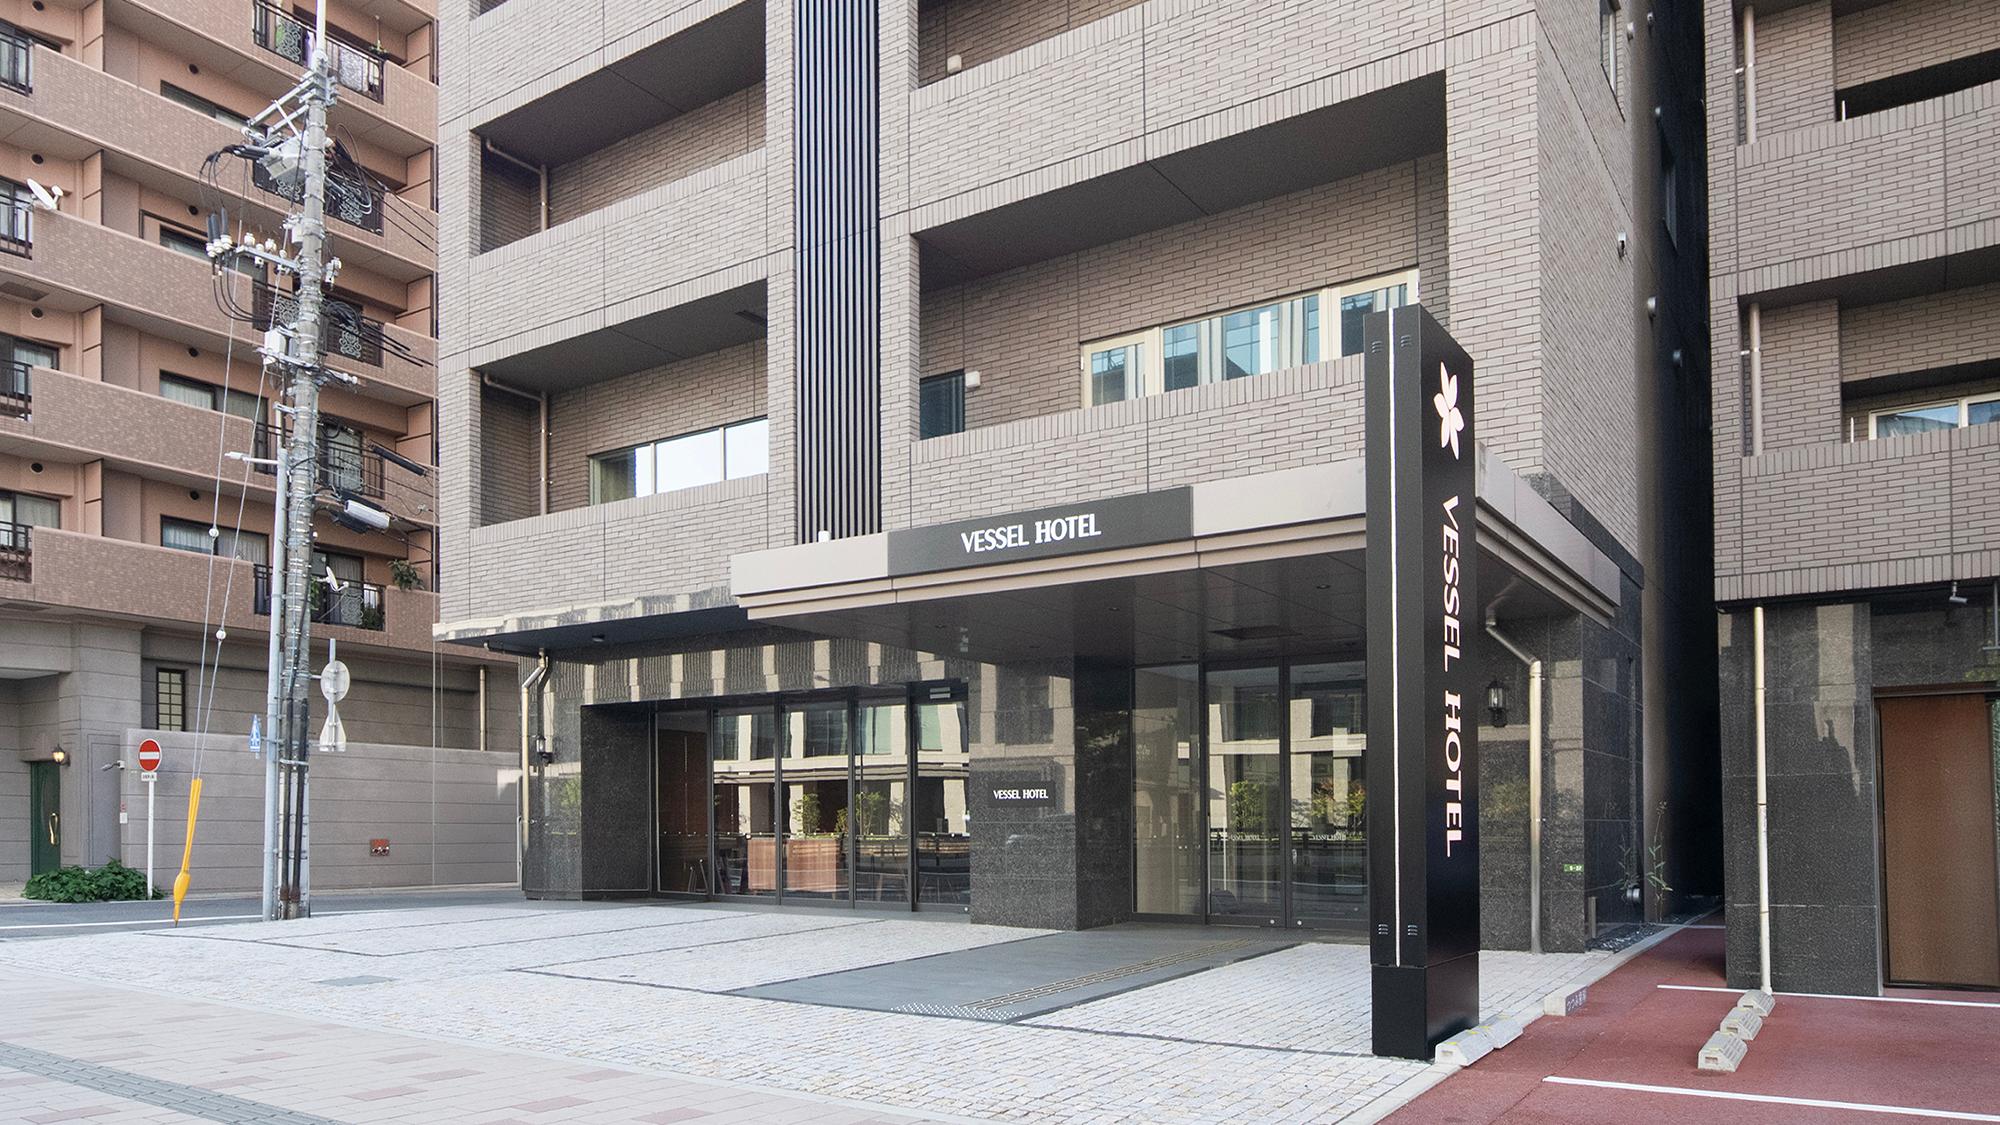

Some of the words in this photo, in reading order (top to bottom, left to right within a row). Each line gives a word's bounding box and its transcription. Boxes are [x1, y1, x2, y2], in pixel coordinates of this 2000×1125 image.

[960, 524, 1030, 553] VESSEL
[1034, 513, 1102, 544] HOTEL
[1442, 495, 1461, 673] VESSEL
[993, 789, 1021, 800] VESSEL
[1022, 788, 1049, 799] HOTEL
[1444, 690, 1462, 858] HOTEL
